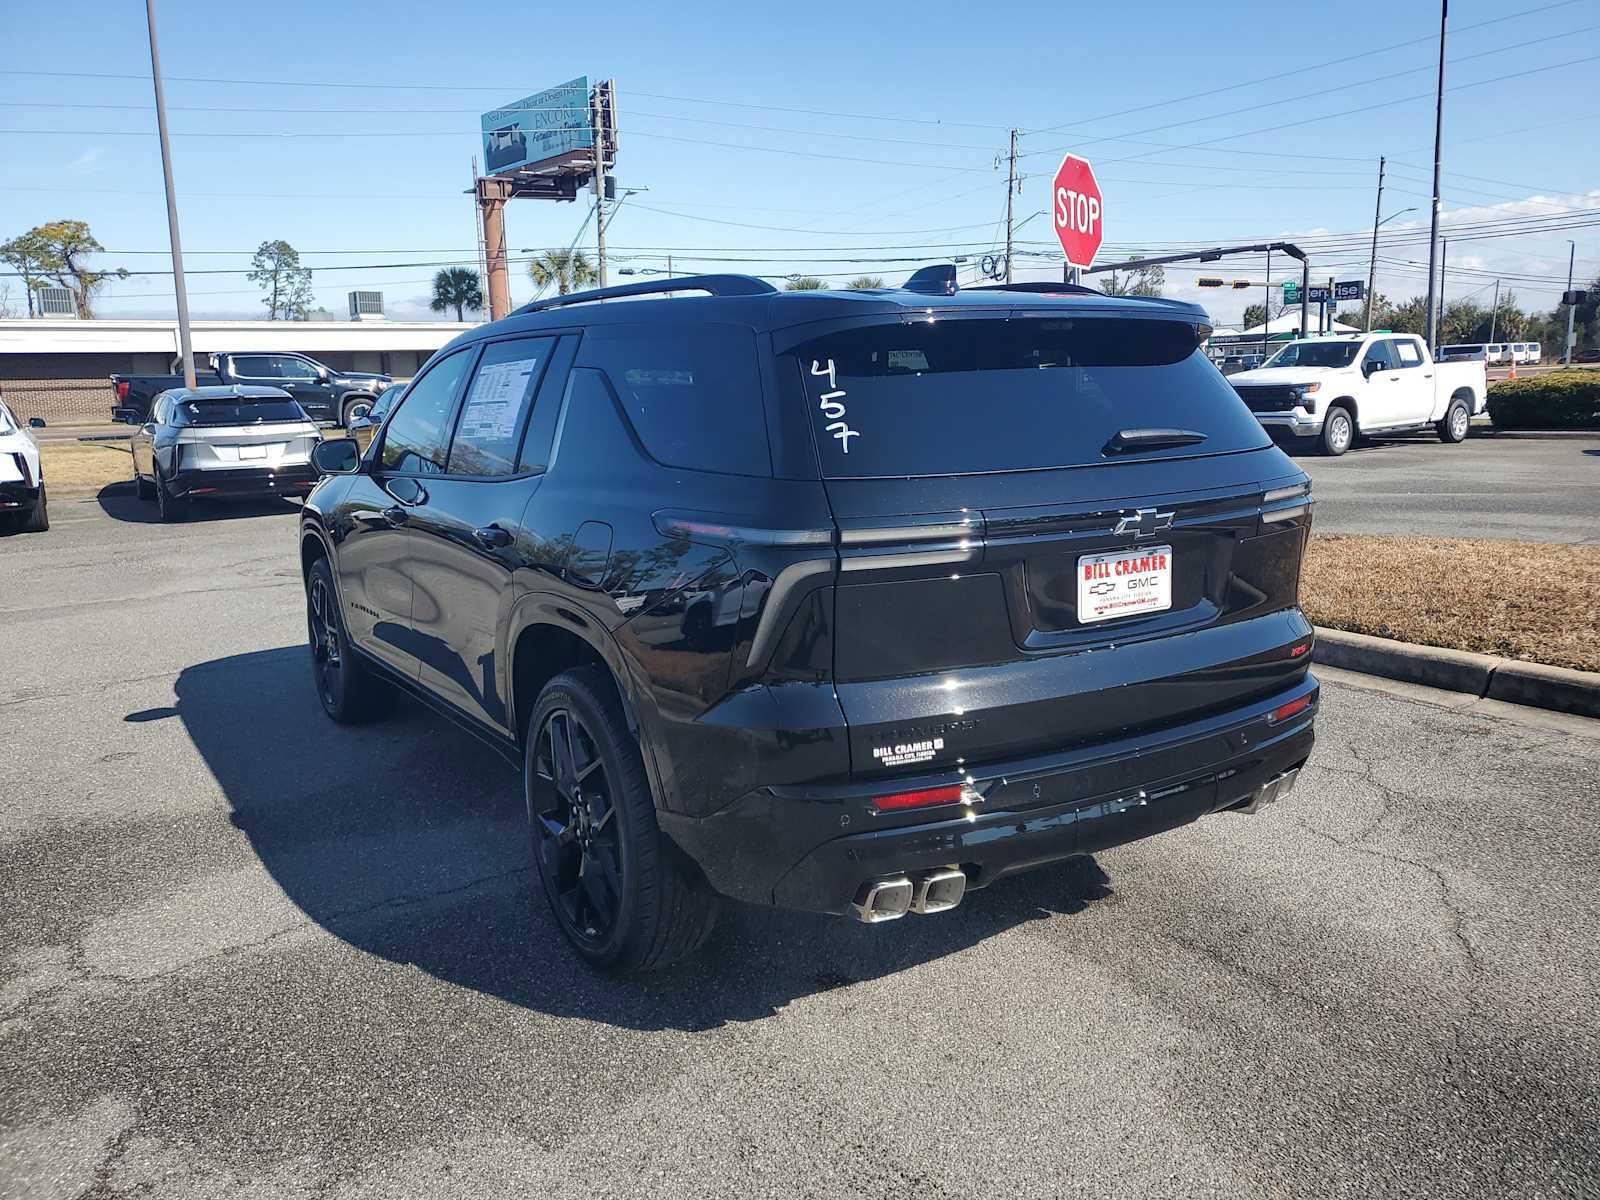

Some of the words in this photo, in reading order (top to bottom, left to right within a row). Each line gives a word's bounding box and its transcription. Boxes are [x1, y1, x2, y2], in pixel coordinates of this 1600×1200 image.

[1057, 186, 1100, 235] STOP
[1085, 562, 1110, 580] BILL
[1115, 554, 1166, 576] CRAMER
[1128, 577, 1158, 589] GMC
[873, 746, 892, 758] BILL
[895, 741, 933, 754] CRAMER
